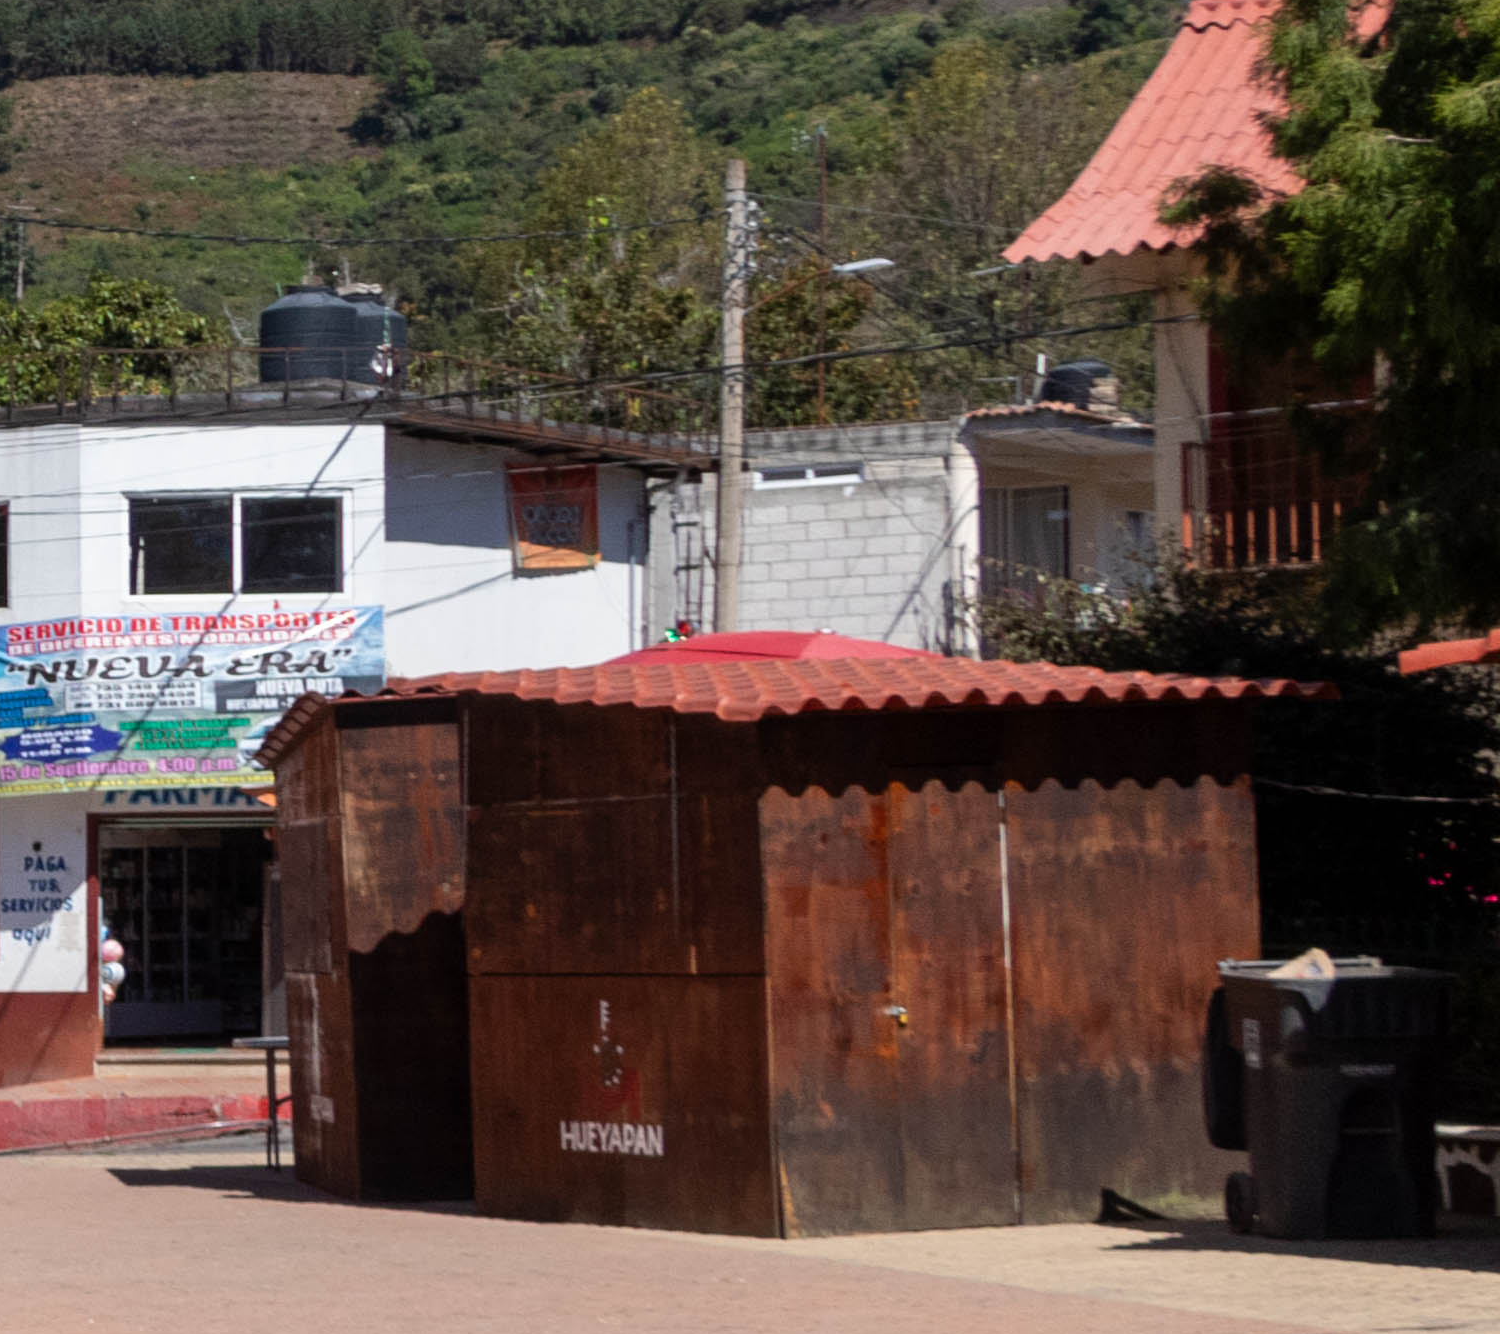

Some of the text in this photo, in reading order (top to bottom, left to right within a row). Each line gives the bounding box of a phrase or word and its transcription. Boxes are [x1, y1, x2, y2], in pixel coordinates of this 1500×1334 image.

[8, 610, 356, 642] SERVICIO DE TRANSPORTES
[7, 642, 37, 656] DE
[38, 633, 175, 654] DIFERENTES
[20, 764, 42, 779] de
[44, 759, 149, 778] Septiembre
[157, 756, 197, 773] 4:00
[23, 855, 67, 873] PAGA
[1, 896, 73, 913] SERVICIOS
[560, 1120, 665, 1157] HUEYAPAN
